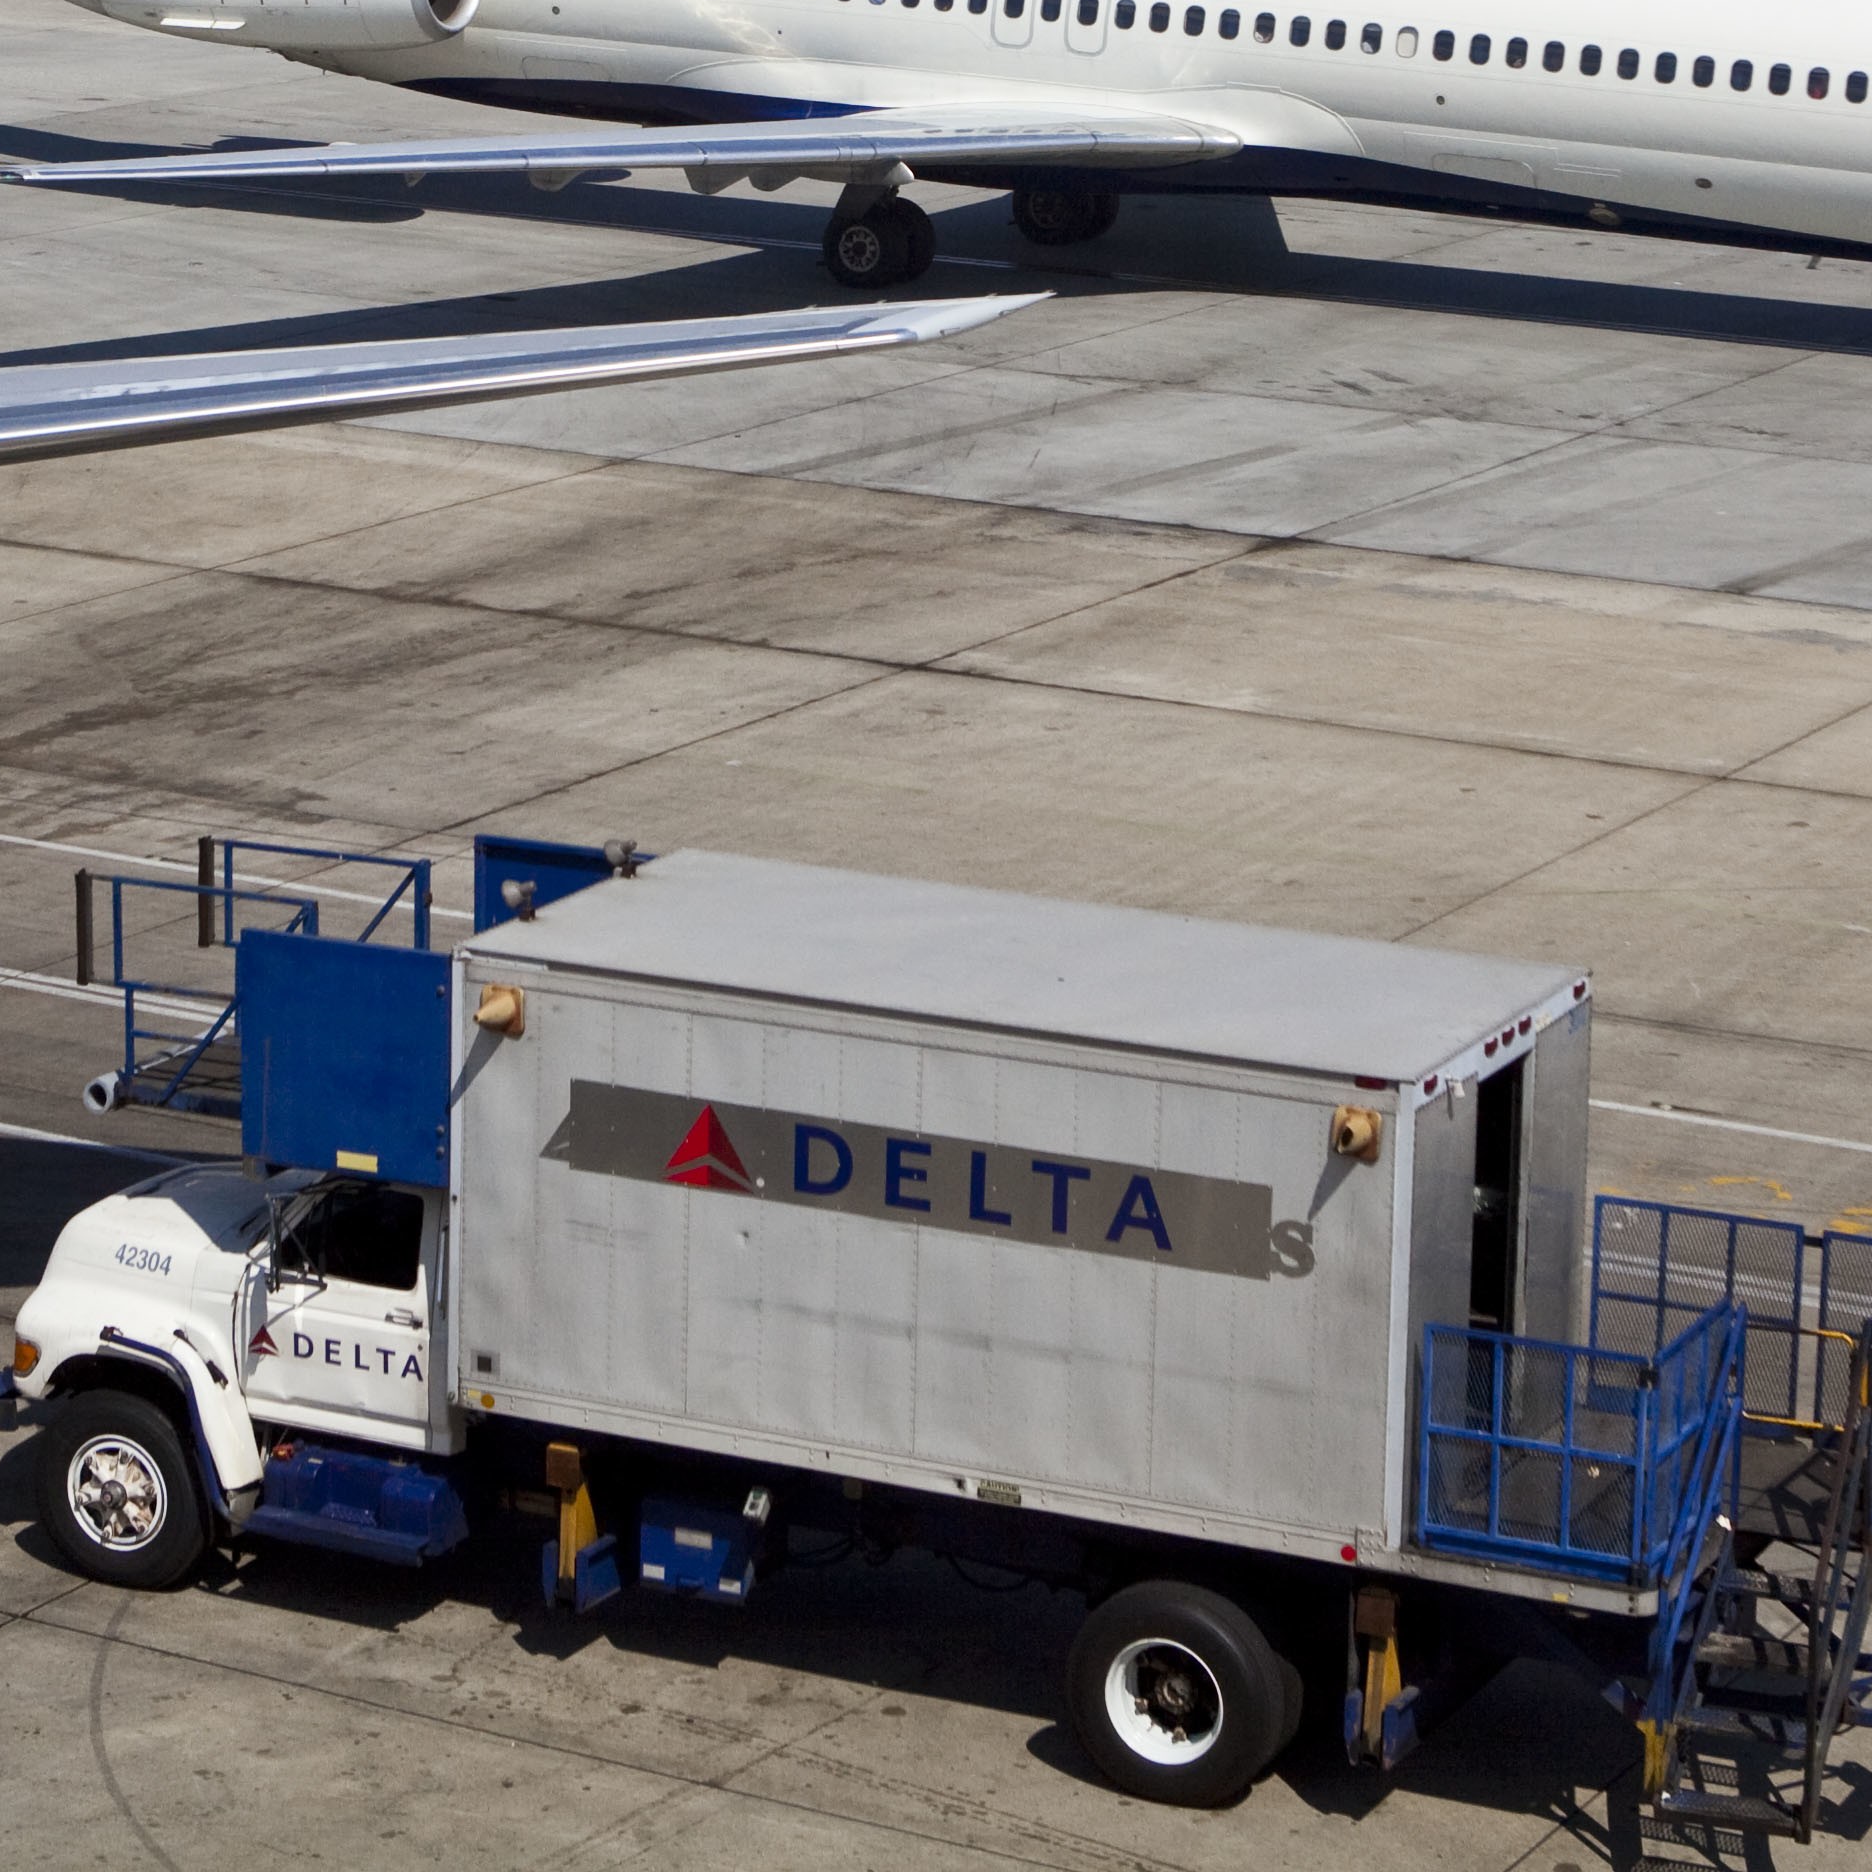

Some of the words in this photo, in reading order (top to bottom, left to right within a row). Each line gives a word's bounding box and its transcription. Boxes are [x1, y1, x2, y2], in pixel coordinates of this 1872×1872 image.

[793, 1122, 1172, 1251] DELTA
[115, 1243, 173, 1276] 42304
[293, 1331, 424, 1382] DELTA
